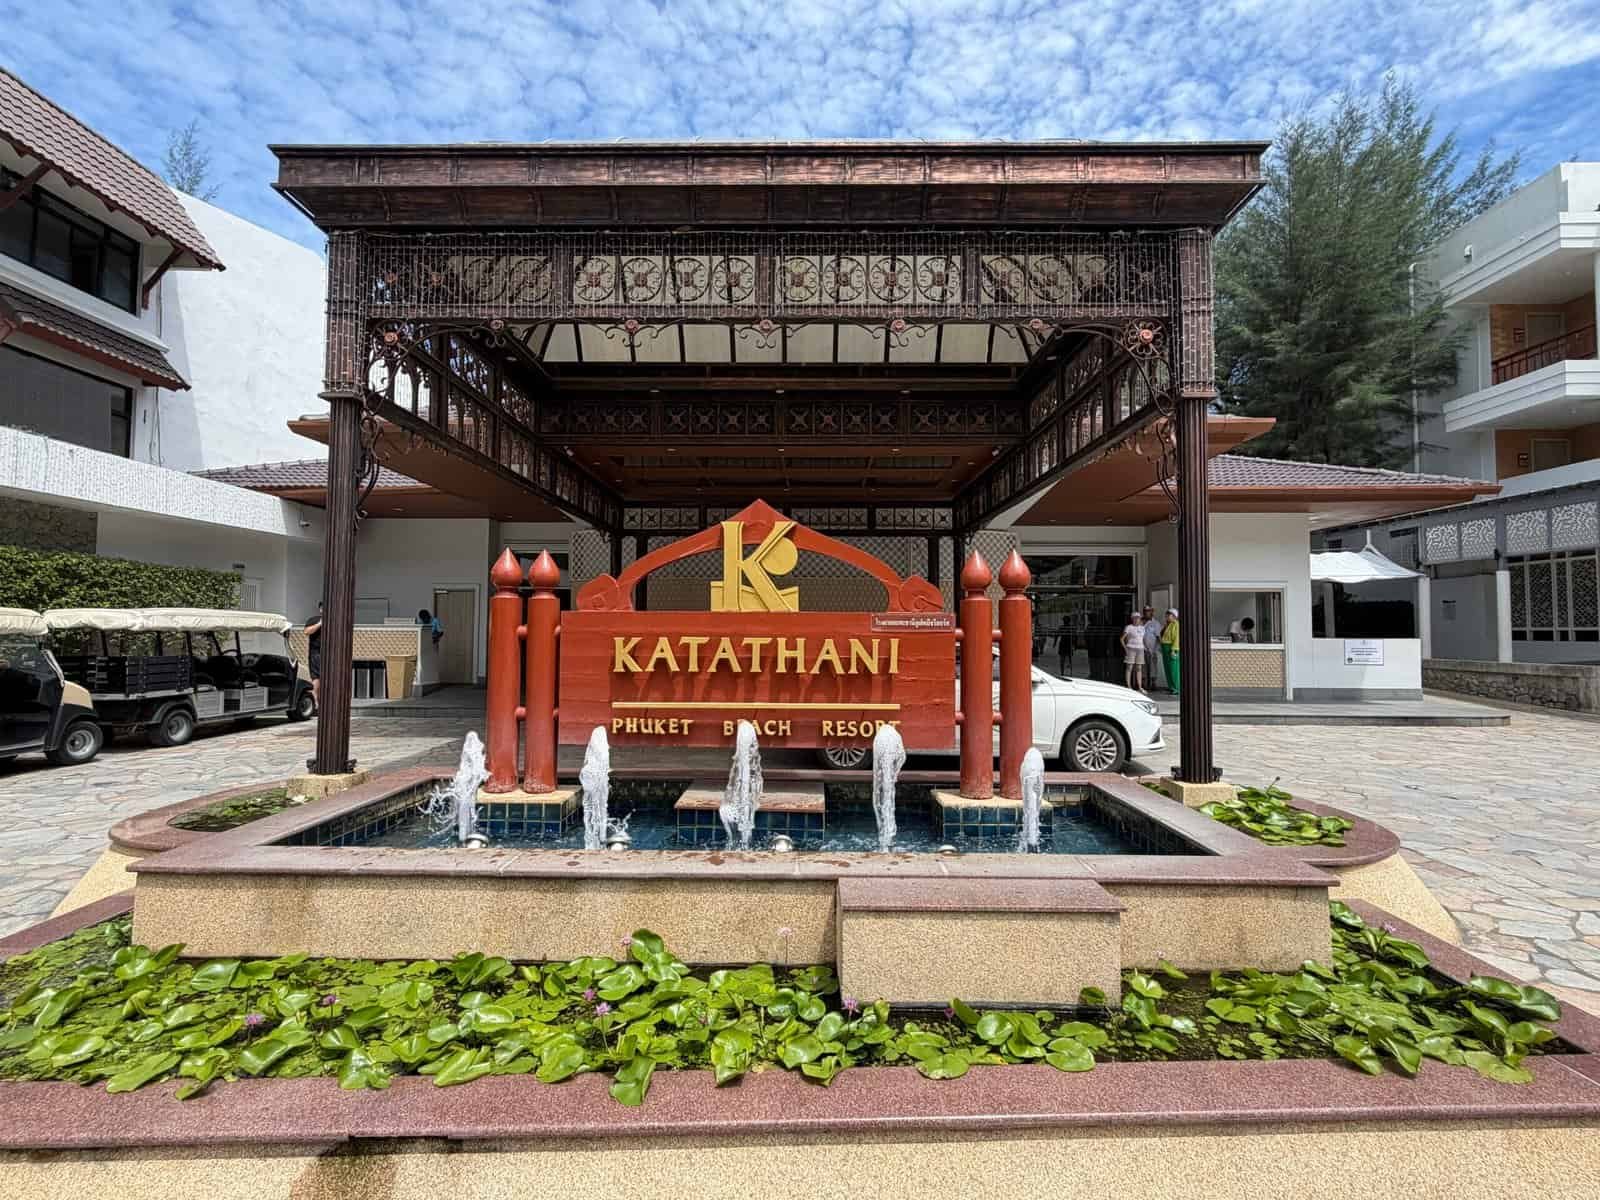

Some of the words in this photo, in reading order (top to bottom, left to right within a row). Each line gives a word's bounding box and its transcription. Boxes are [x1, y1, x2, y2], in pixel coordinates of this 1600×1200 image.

[720, 521, 798, 612] K
[612, 636, 900, 674] KATATHANI
[611, 717, 694, 735] PHUKET
[723, 719, 792, 736] BACH
